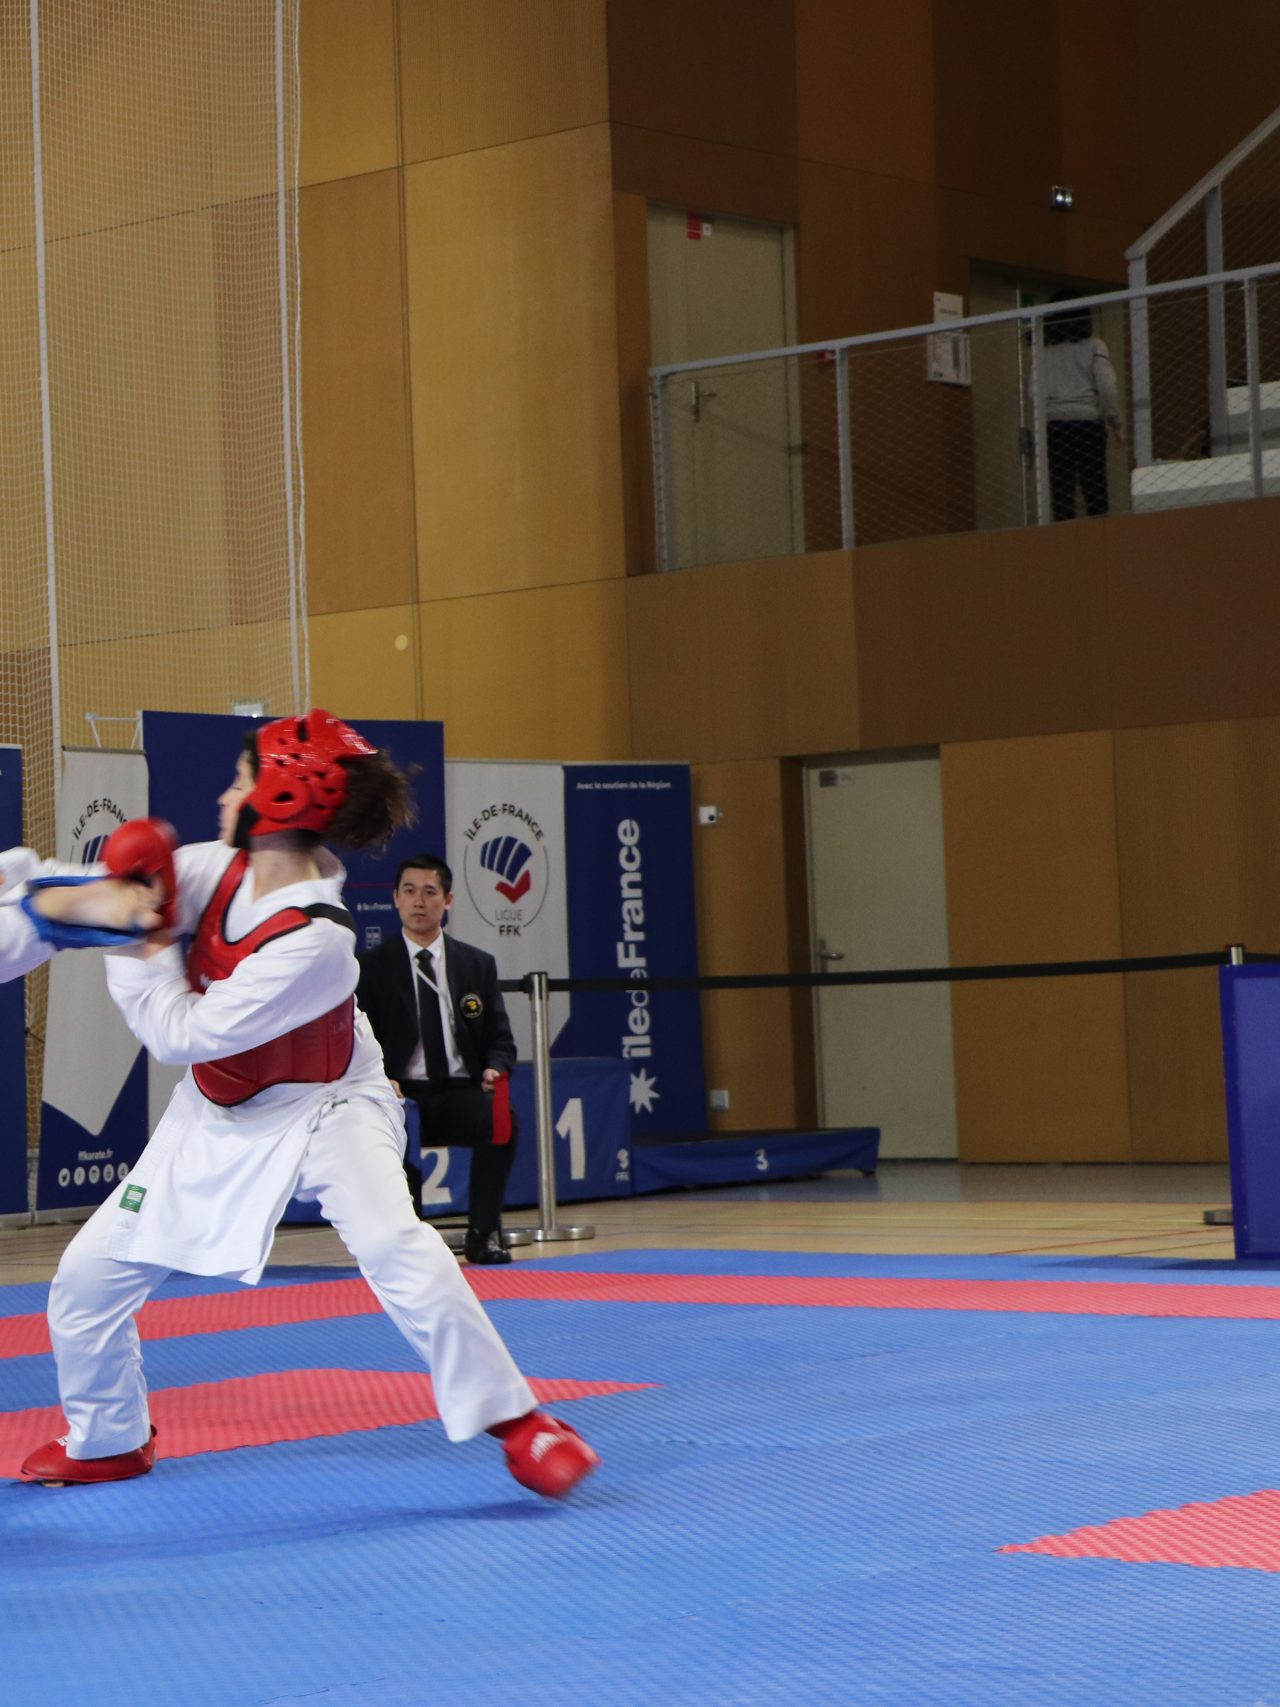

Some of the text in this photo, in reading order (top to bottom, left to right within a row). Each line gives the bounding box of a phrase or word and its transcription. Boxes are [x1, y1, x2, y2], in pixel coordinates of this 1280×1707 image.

[72, 798, 128, 841] ÎLE-DE-FRAN
[463, 803, 544, 841] ÎLE-DE-FRANCE
[495, 909, 523, 921] LIGUE
[498, 925, 521, 937] FFK
[555, 1098, 586, 1180] 1
[420, 1147, 453, 1205] 2
[755, 1149, 769, 1171] 3
